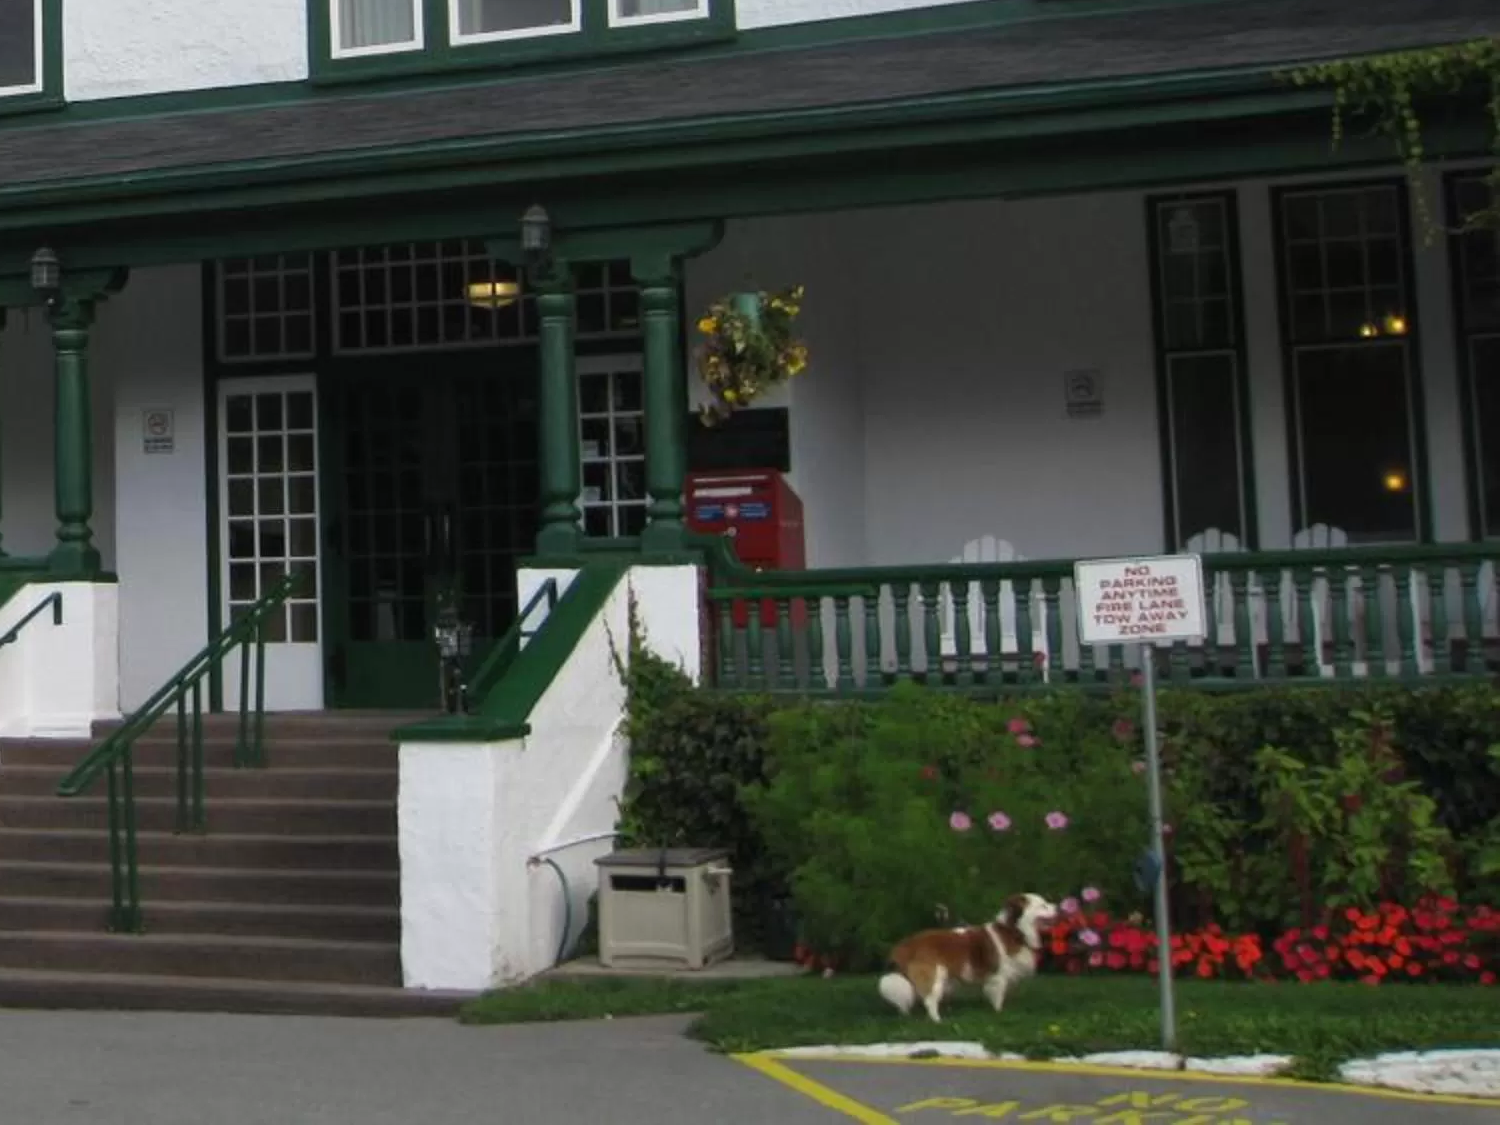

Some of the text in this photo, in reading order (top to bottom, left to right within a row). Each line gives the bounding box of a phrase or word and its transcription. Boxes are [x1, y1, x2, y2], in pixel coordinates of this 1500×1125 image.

[1124, 566, 1150, 576] NO
[1099, 576, 1177, 588] PARKING
[1101, 587, 1178, 600] ANYTIME
[1096, 599, 1184, 612] FIRE LANE
[1093, 610, 1188, 624] TOW AWAY
[1119, 623, 1166, 635] ZONE
[1097, 1090, 1249, 1112] NO
